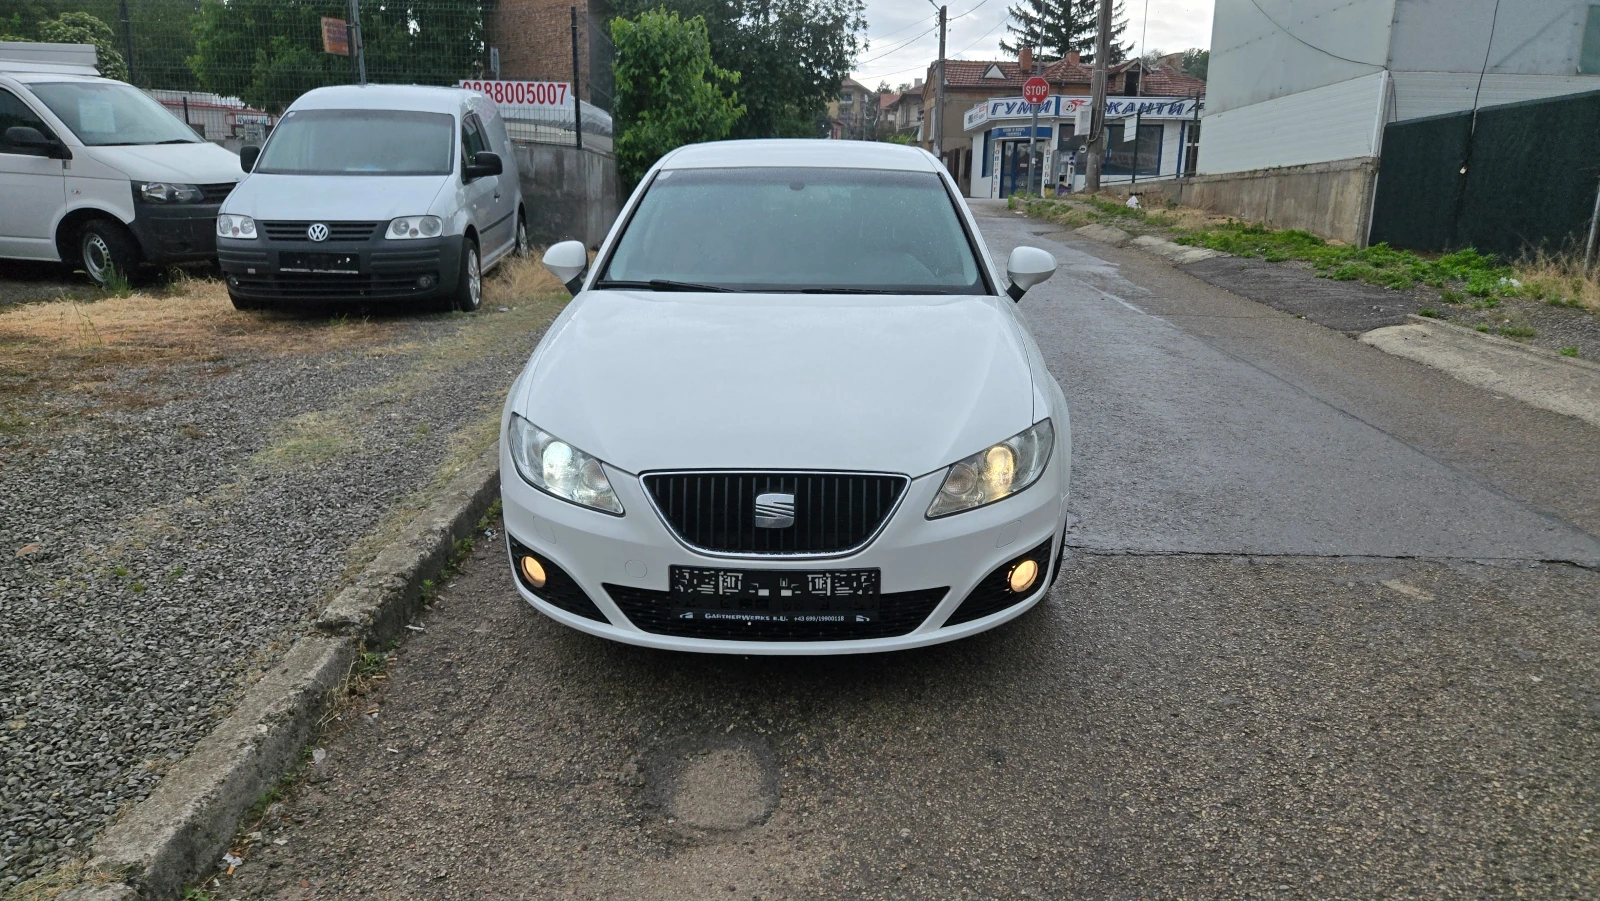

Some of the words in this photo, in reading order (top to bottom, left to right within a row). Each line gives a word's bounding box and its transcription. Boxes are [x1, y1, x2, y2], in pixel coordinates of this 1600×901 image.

[1025, 85, 1047, 96] STOP
[991, 100, 1053, 116] ГУМИ
[1104, 101, 1185, 115] ЖАНТИ
